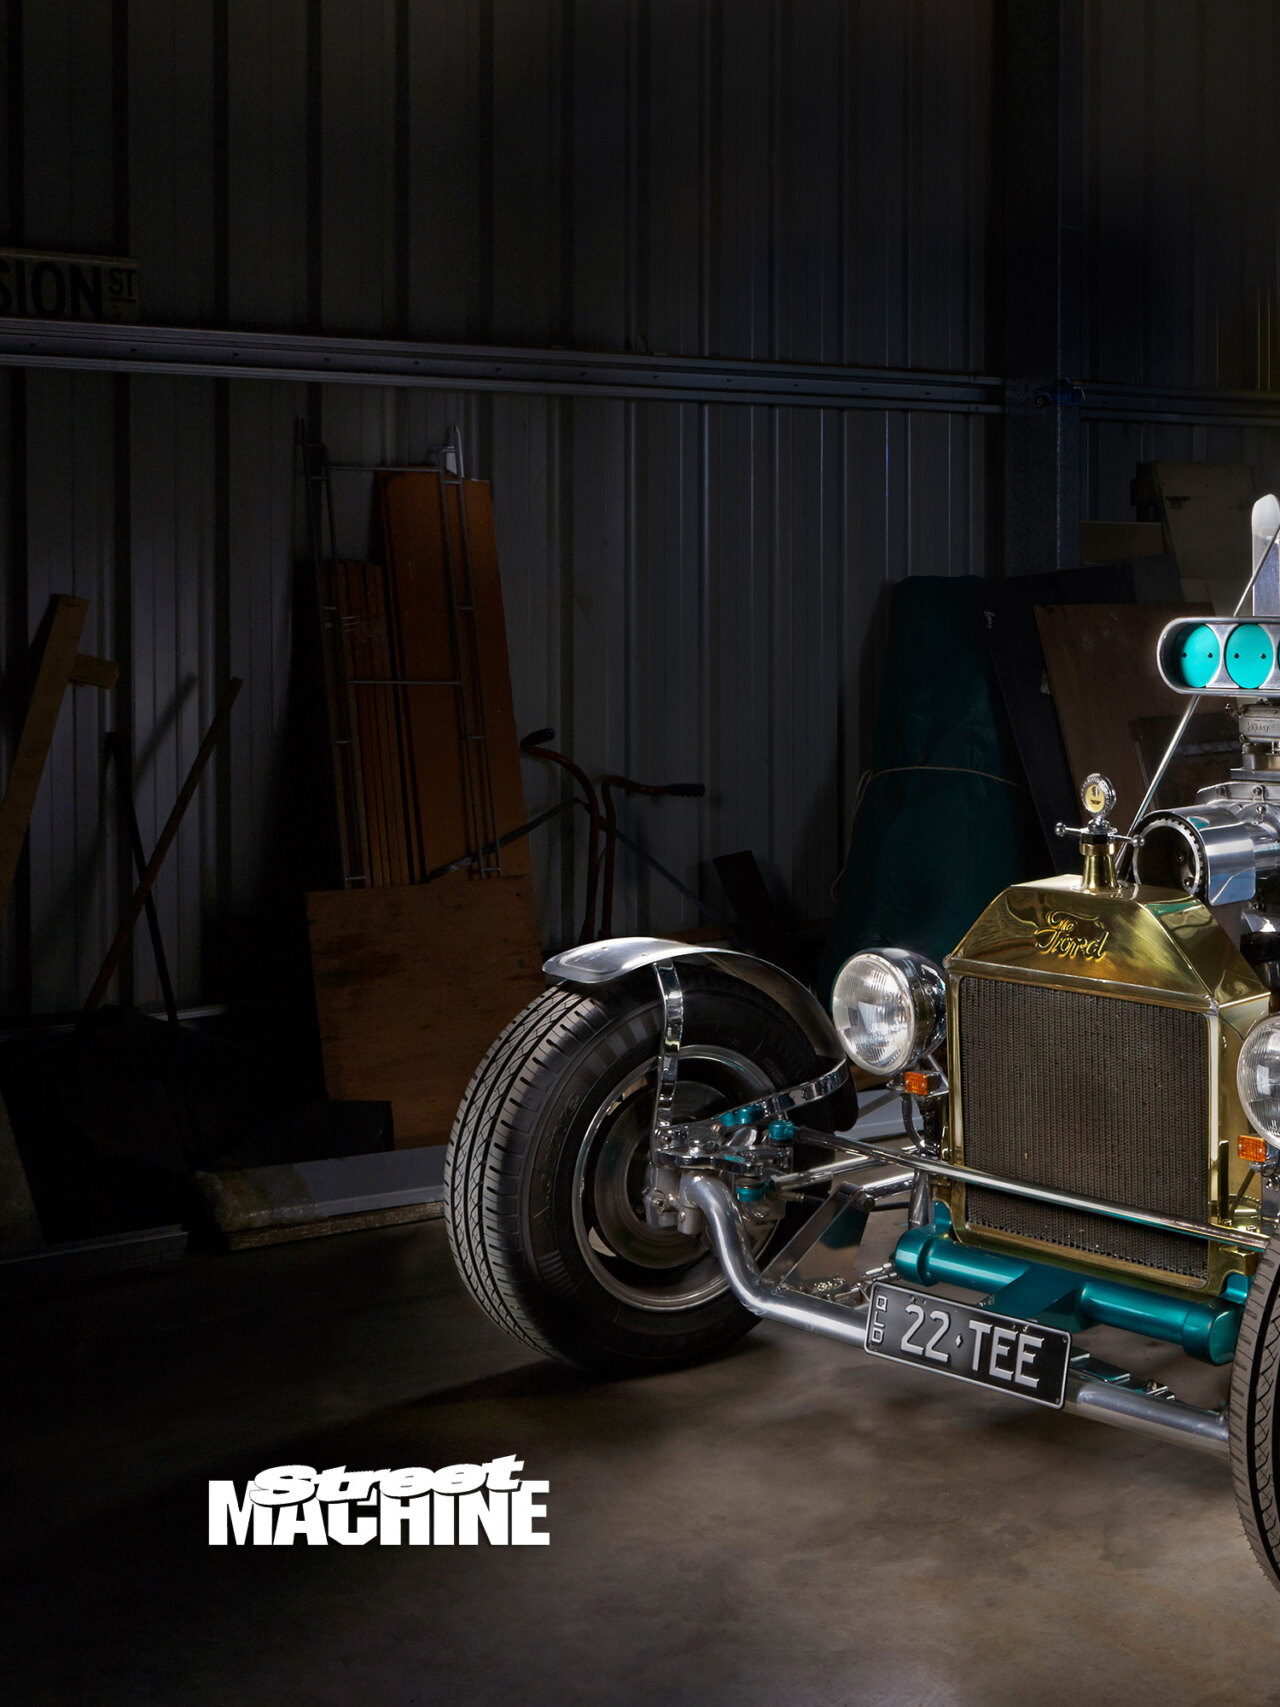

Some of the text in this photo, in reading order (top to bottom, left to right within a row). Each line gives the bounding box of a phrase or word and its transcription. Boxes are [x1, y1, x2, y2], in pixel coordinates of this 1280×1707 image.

[108, 268, 137, 297] ST
[1034, 928, 1109, 963] Ford
[871, 1294, 888, 1344] QLD
[900, 1303, 1045, 1389] 22 TEE
